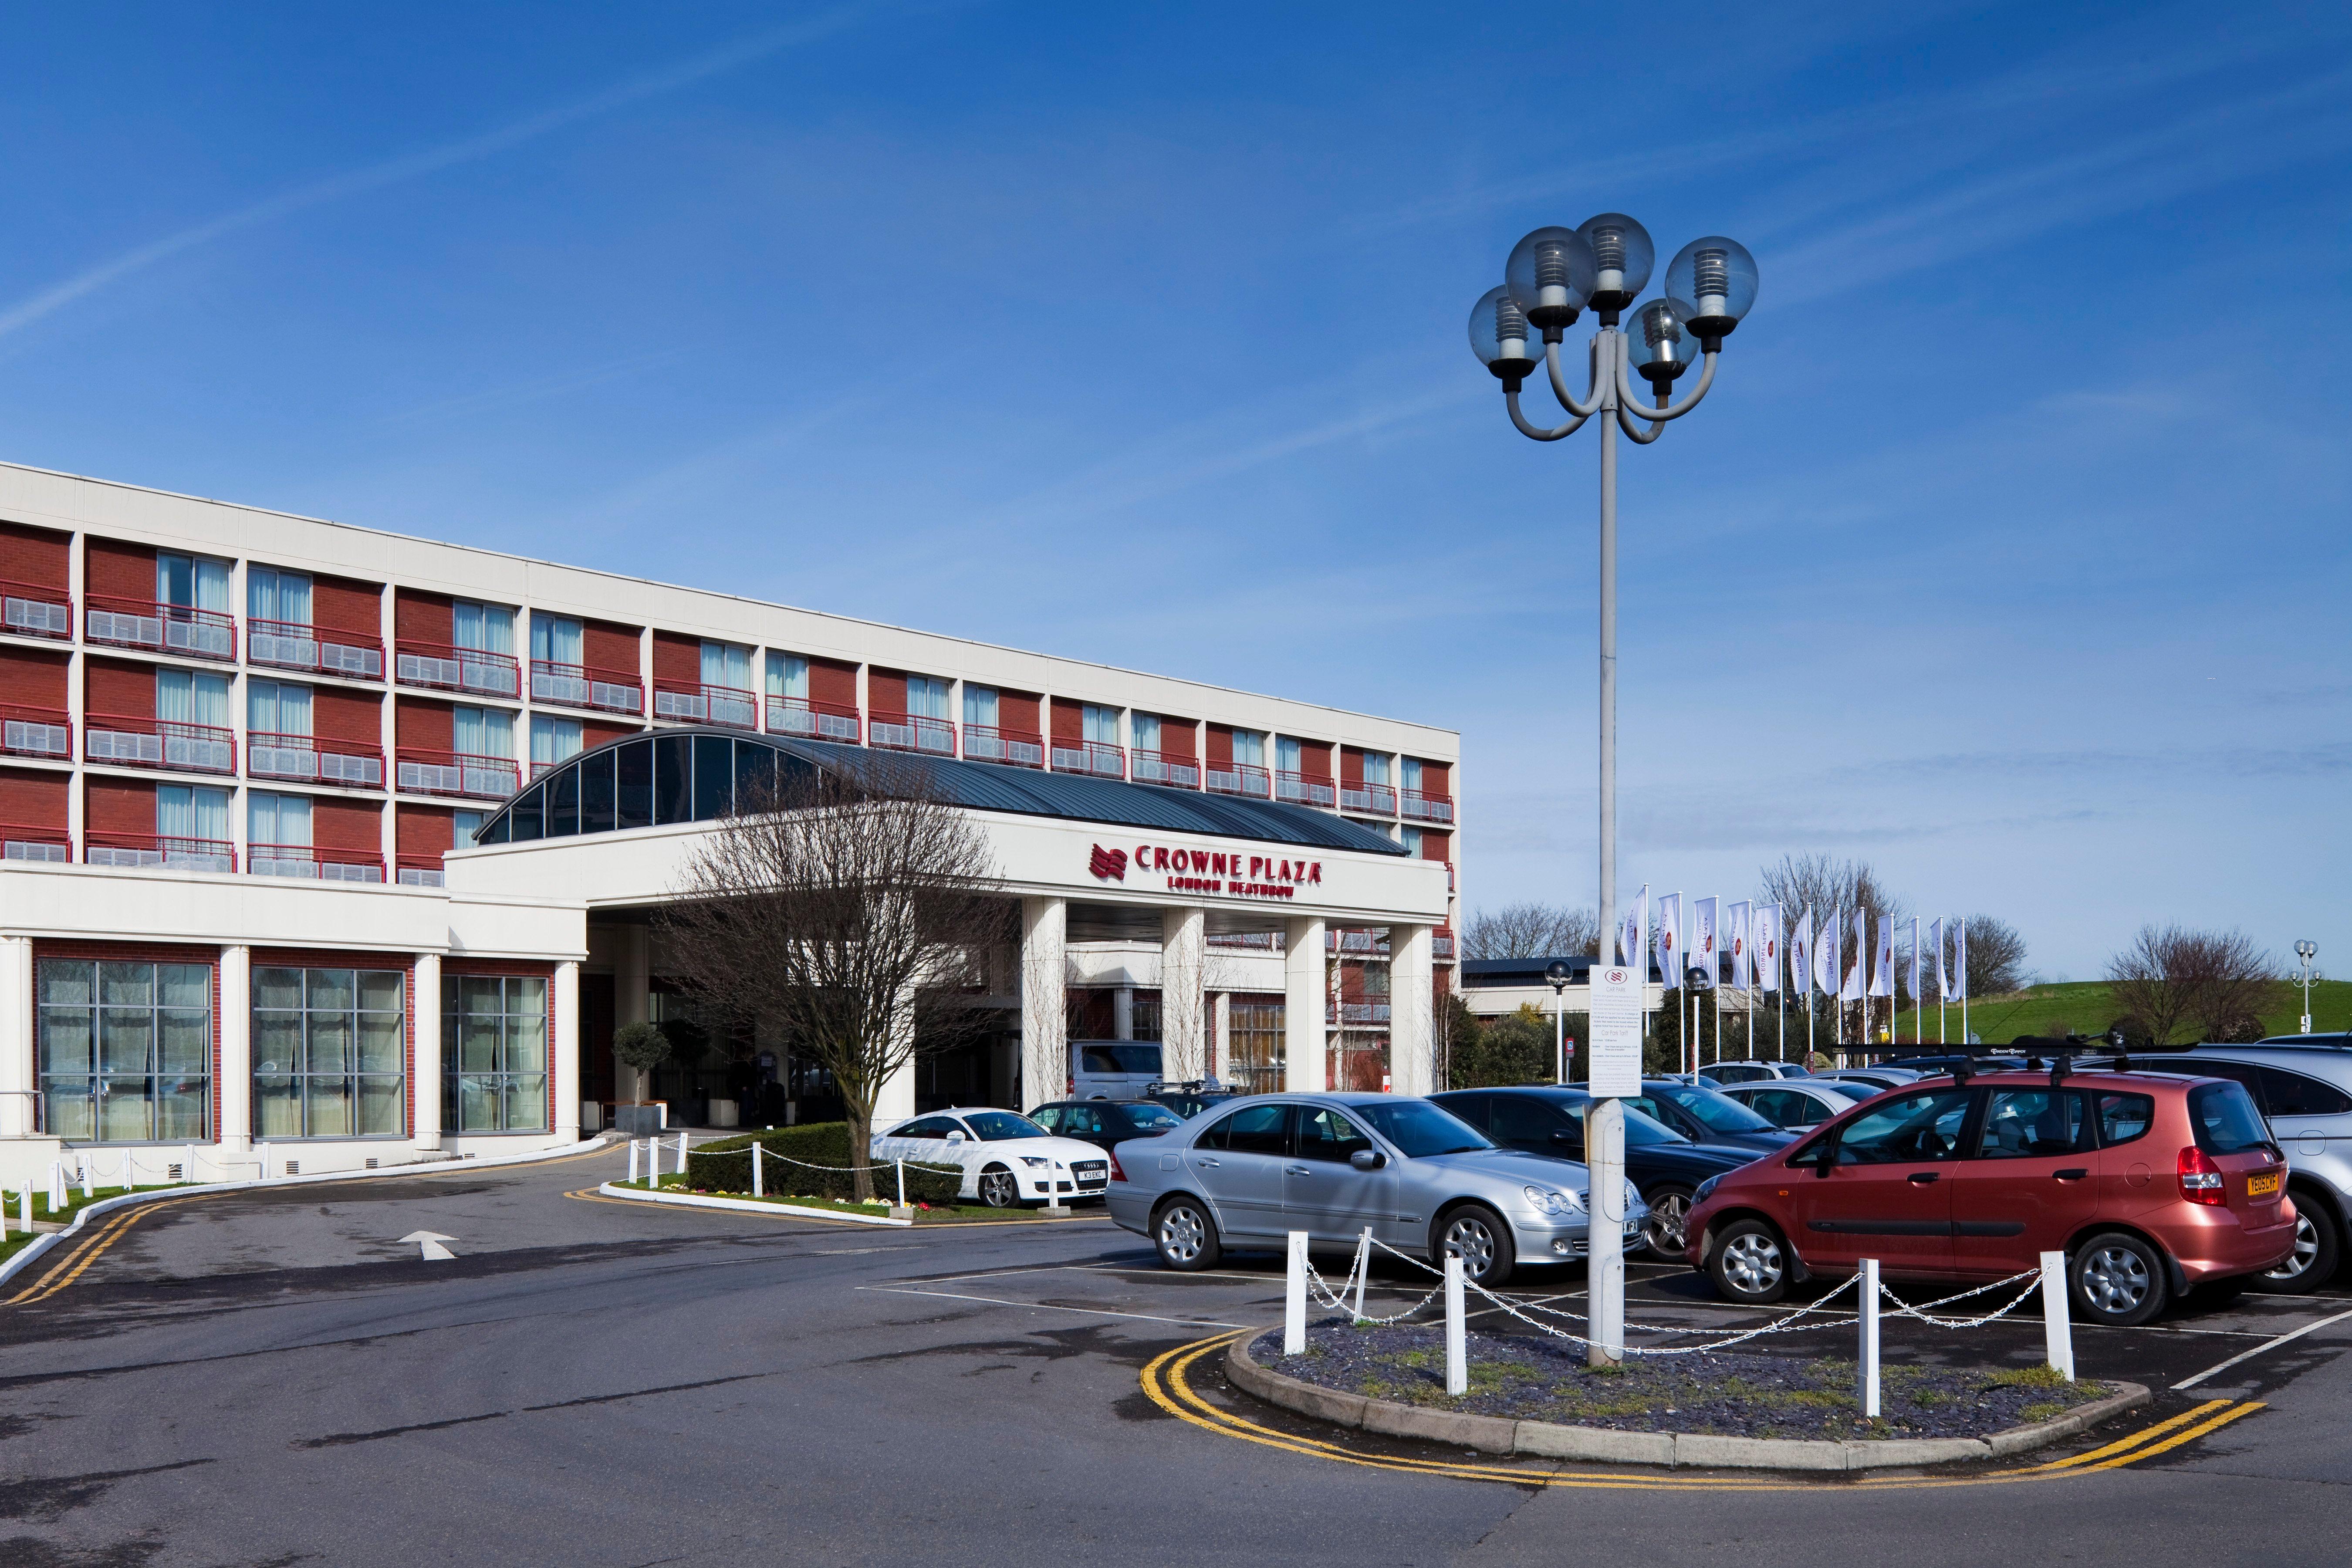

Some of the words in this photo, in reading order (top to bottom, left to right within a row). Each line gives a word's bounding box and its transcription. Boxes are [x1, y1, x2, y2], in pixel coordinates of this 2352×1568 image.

[1135, 845, 1242, 875] CROWNE
[1250, 856, 1321, 882] PLAZA
[1167, 876, 1221, 891] LONDON
[1228, 881, 1294, 896] HEATHROW
